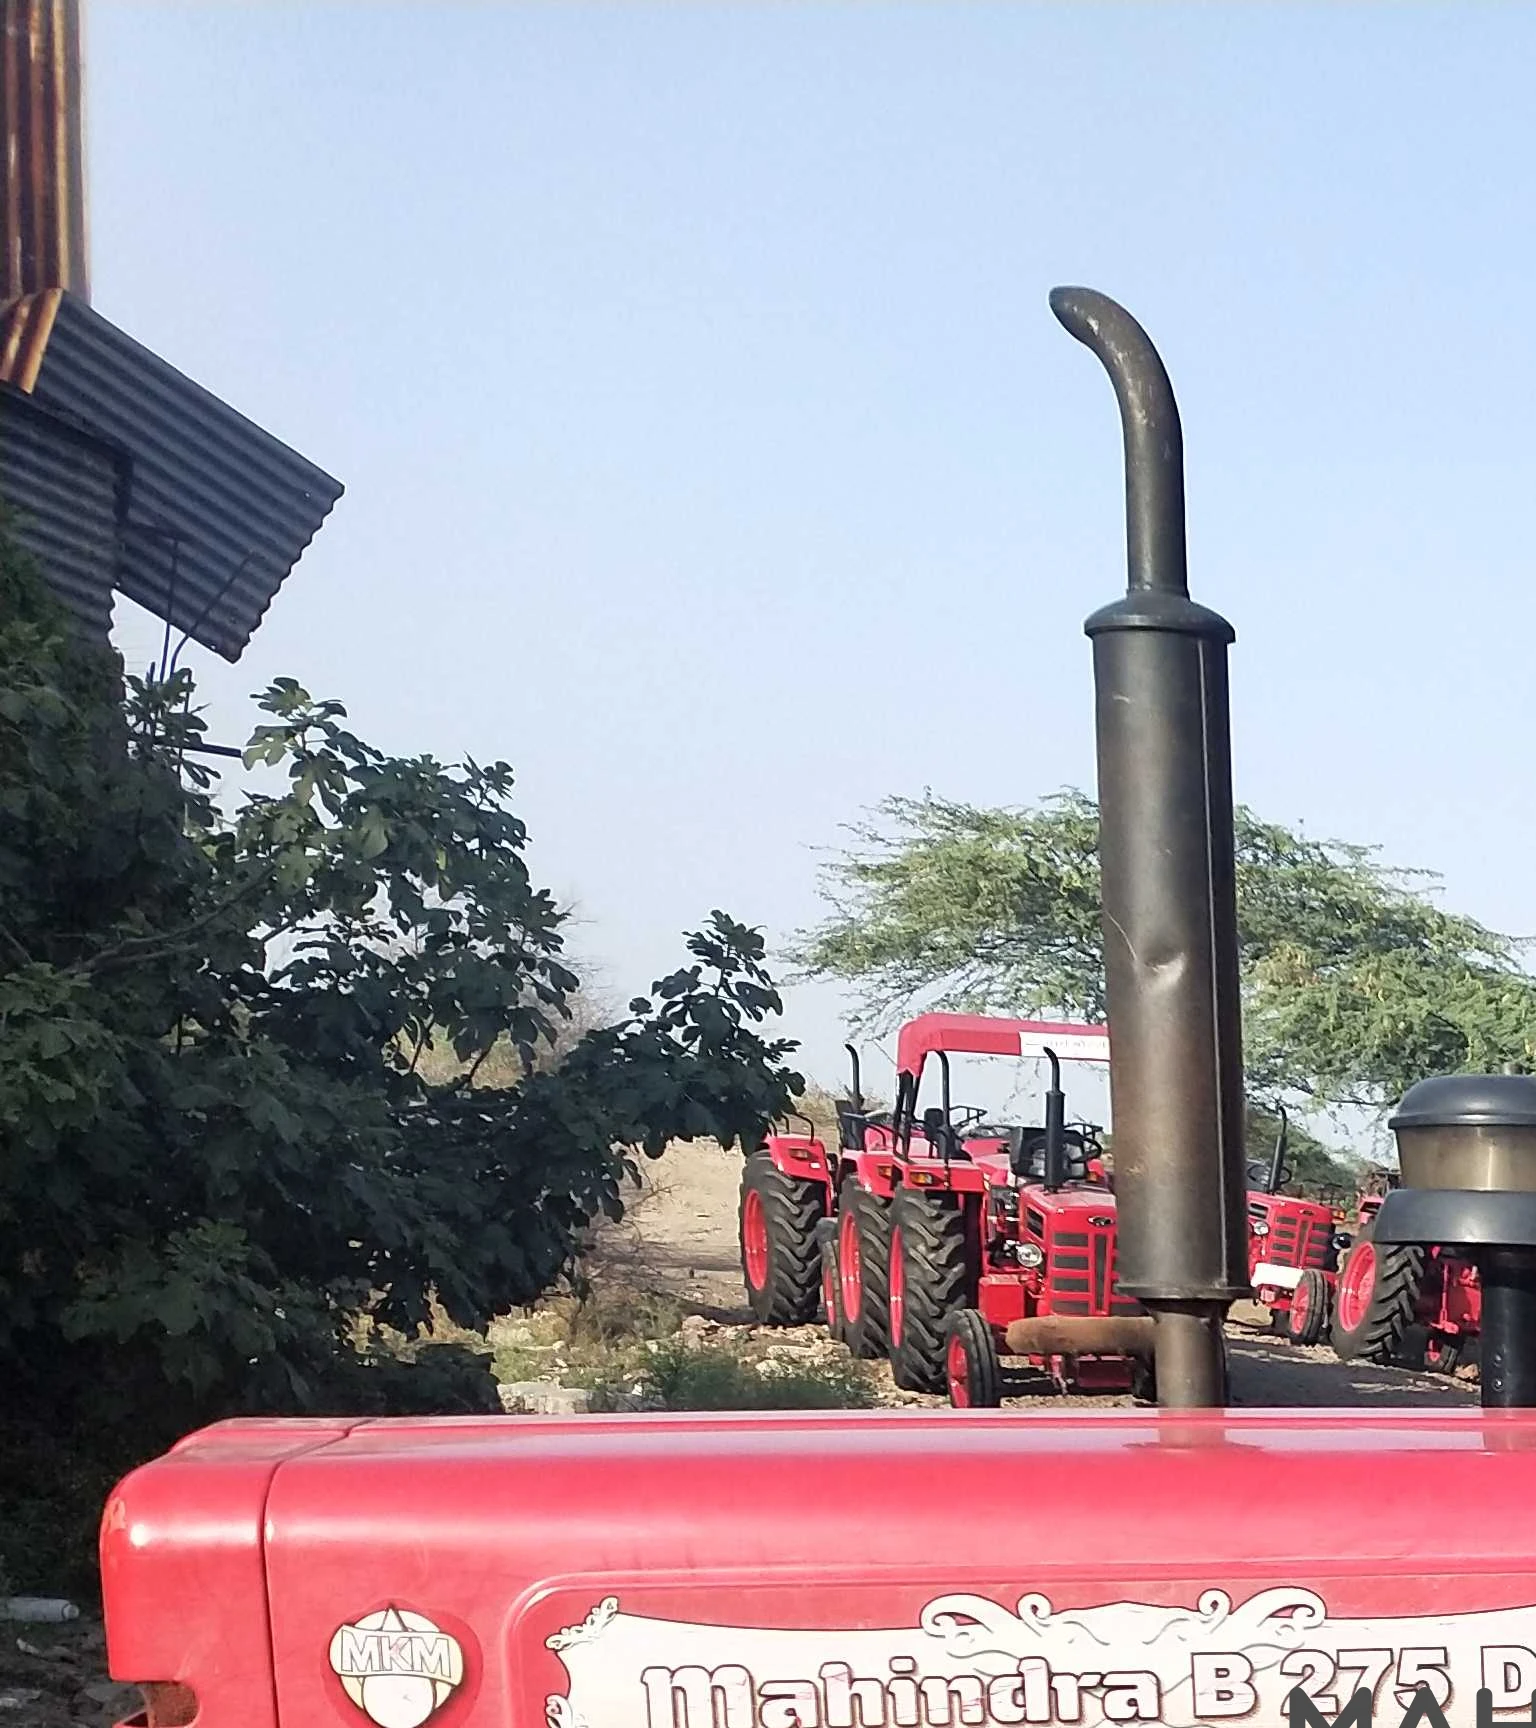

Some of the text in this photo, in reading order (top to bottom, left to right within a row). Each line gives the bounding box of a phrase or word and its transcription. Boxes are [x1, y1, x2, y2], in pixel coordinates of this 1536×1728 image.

[340, 1629, 452, 1678] MKM
[1190, 1651, 1257, 1720] B
[1279, 1646, 1453, 1717] 275
